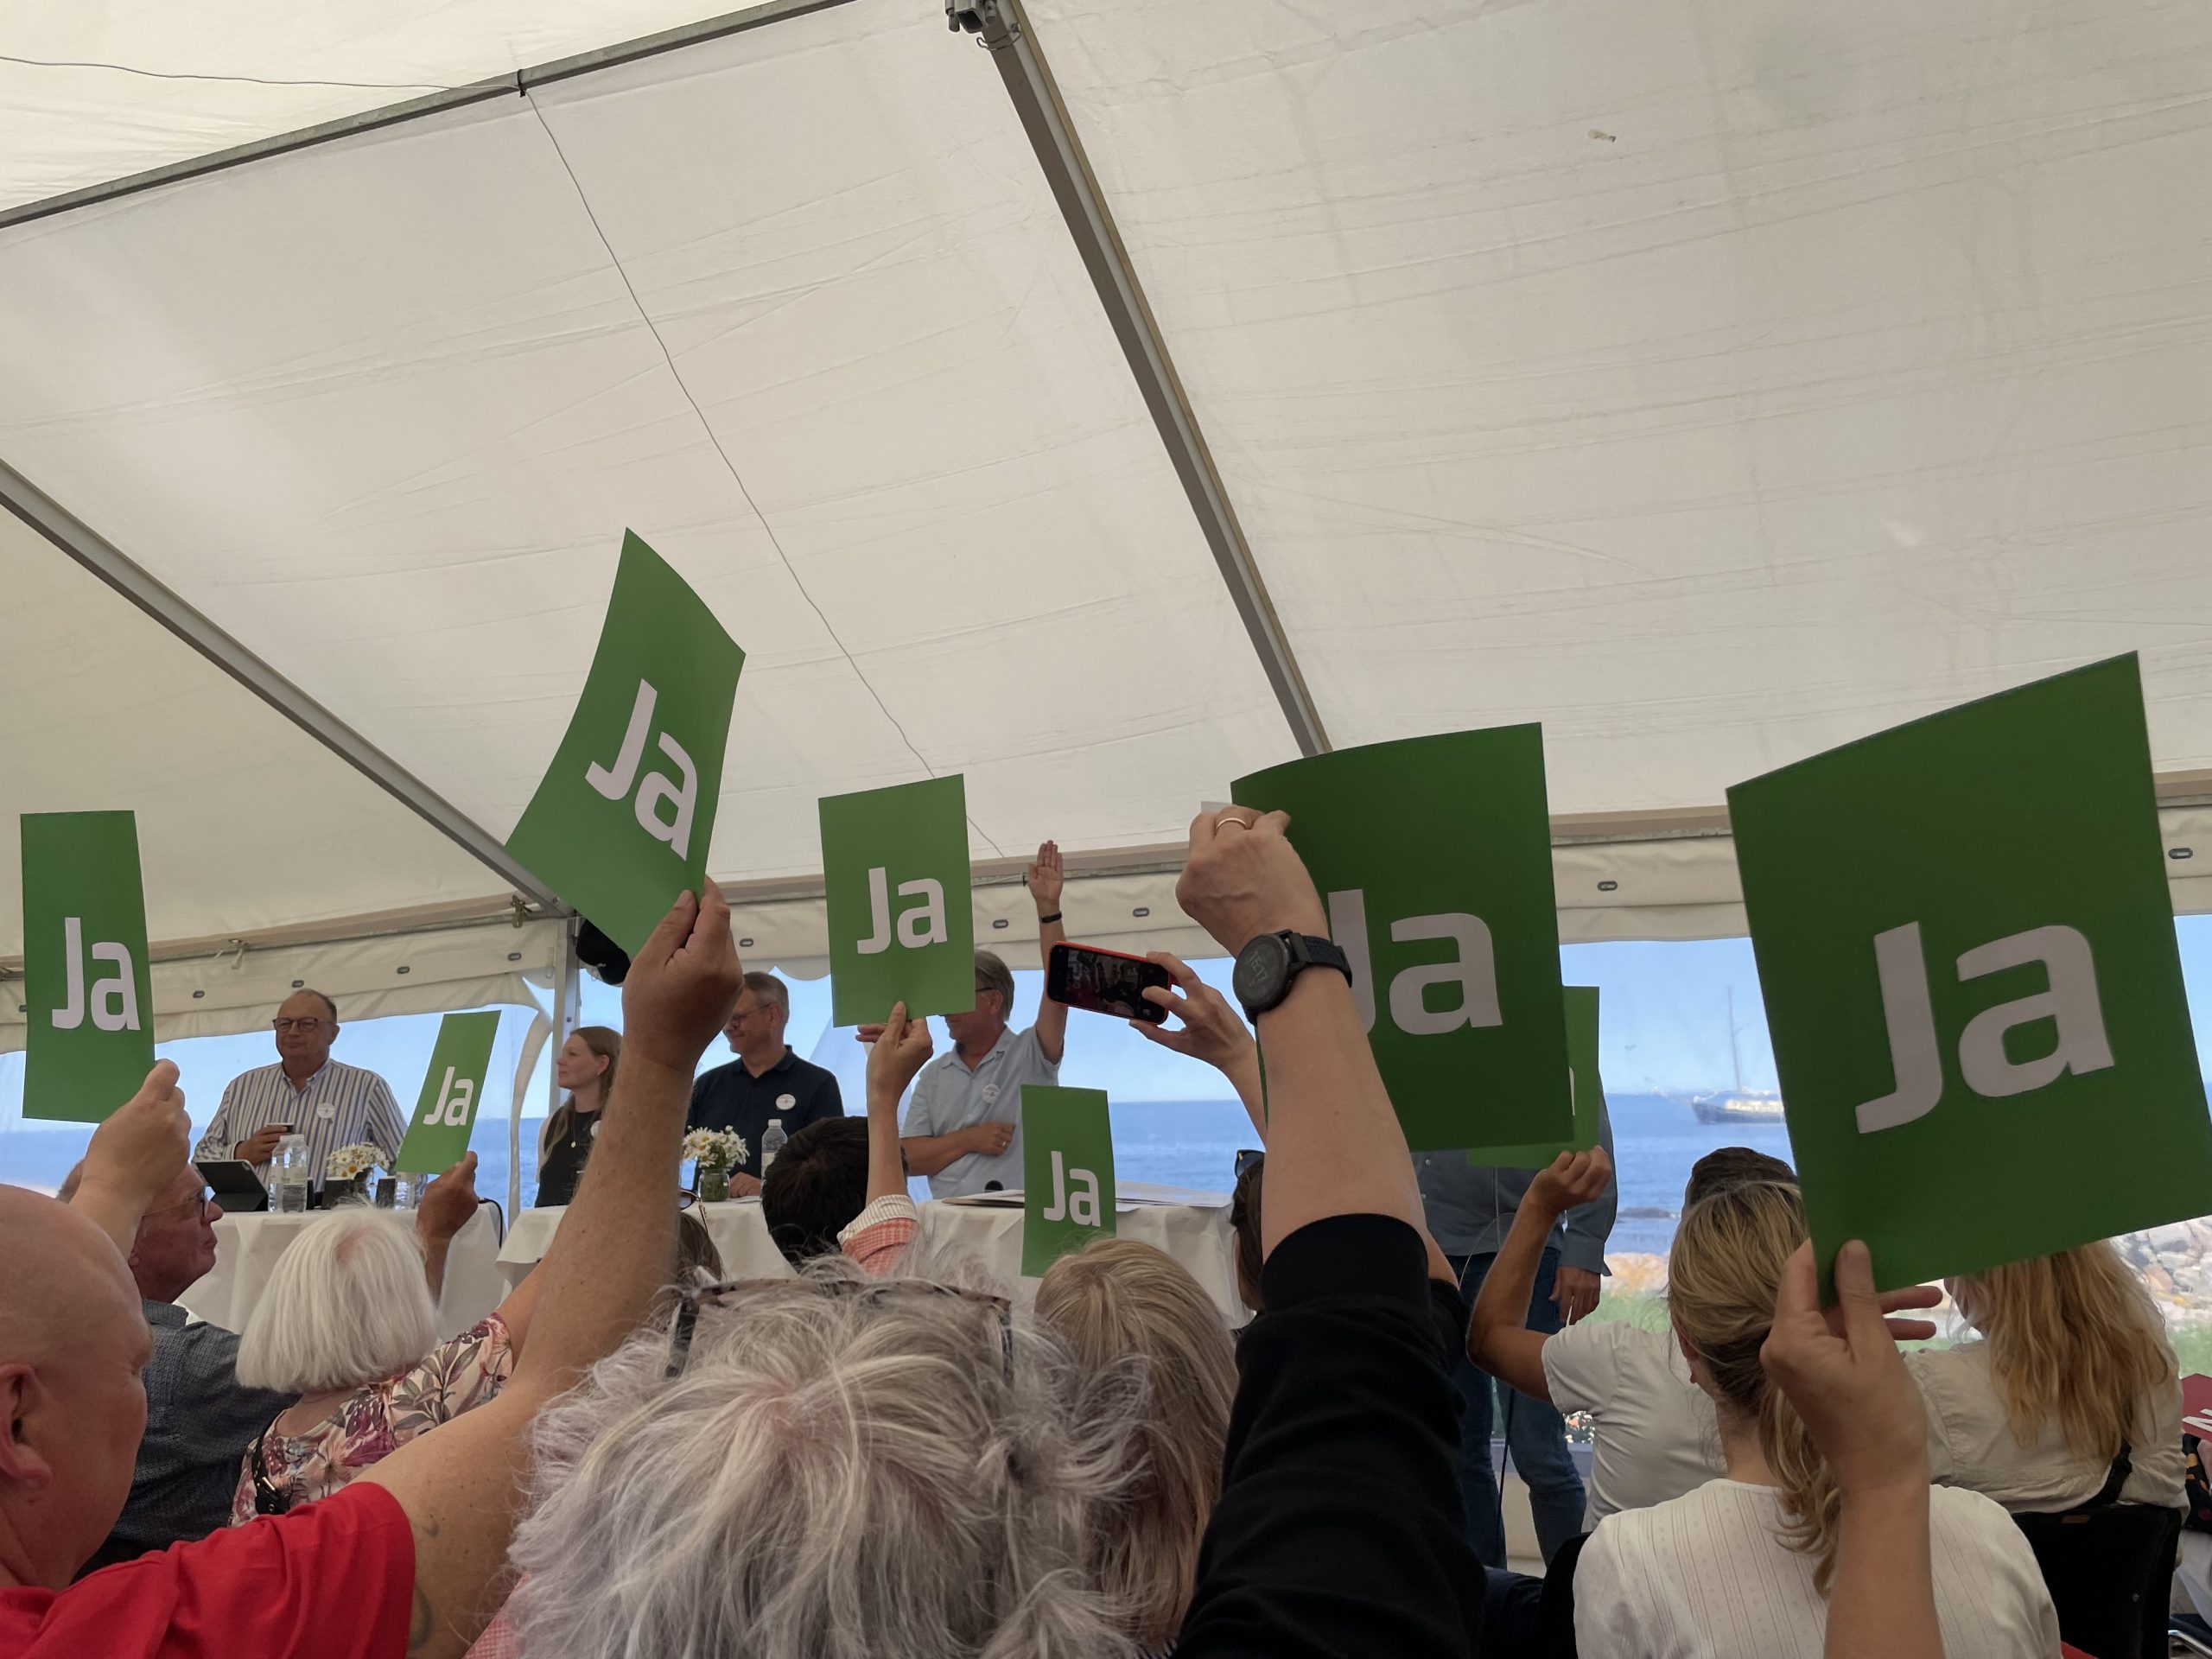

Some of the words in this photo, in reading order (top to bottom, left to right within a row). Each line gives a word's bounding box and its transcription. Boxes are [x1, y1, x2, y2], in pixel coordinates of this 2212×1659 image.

[585, 679, 698, 861] Ja
[856, 867, 948, 954] Ja
[1327, 888, 1503, 1035] Ja
[51, 917, 141, 1032] Ja
[1855, 921, 2115, 1134] Ja
[423, 1065, 474, 1127] Ja
[1043, 1150, 1101, 1227] Ja
